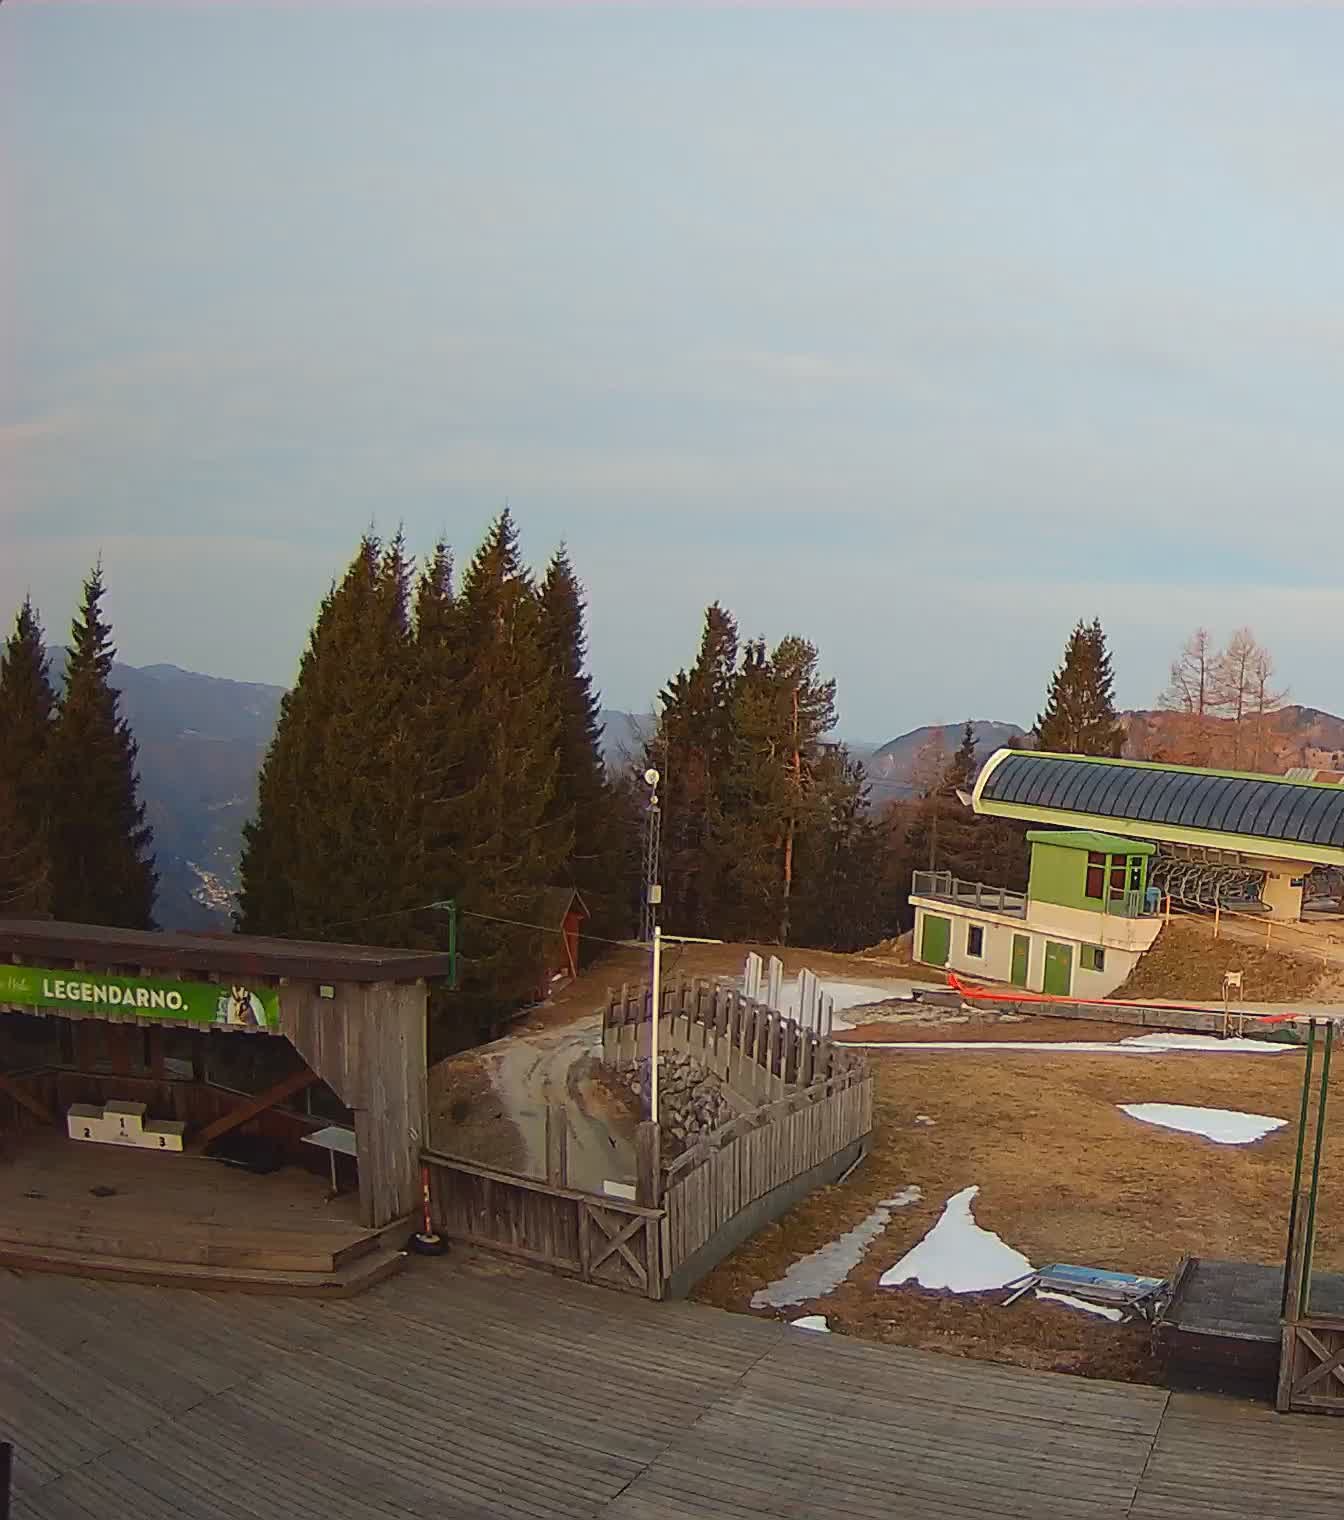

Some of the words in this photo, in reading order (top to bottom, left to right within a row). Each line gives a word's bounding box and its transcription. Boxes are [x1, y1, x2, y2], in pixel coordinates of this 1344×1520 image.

[42, 978, 189, 1011] LEGENDARNO.
[83, 1127, 91, 1138] 2
[159, 1136, 166, 1147] 3
